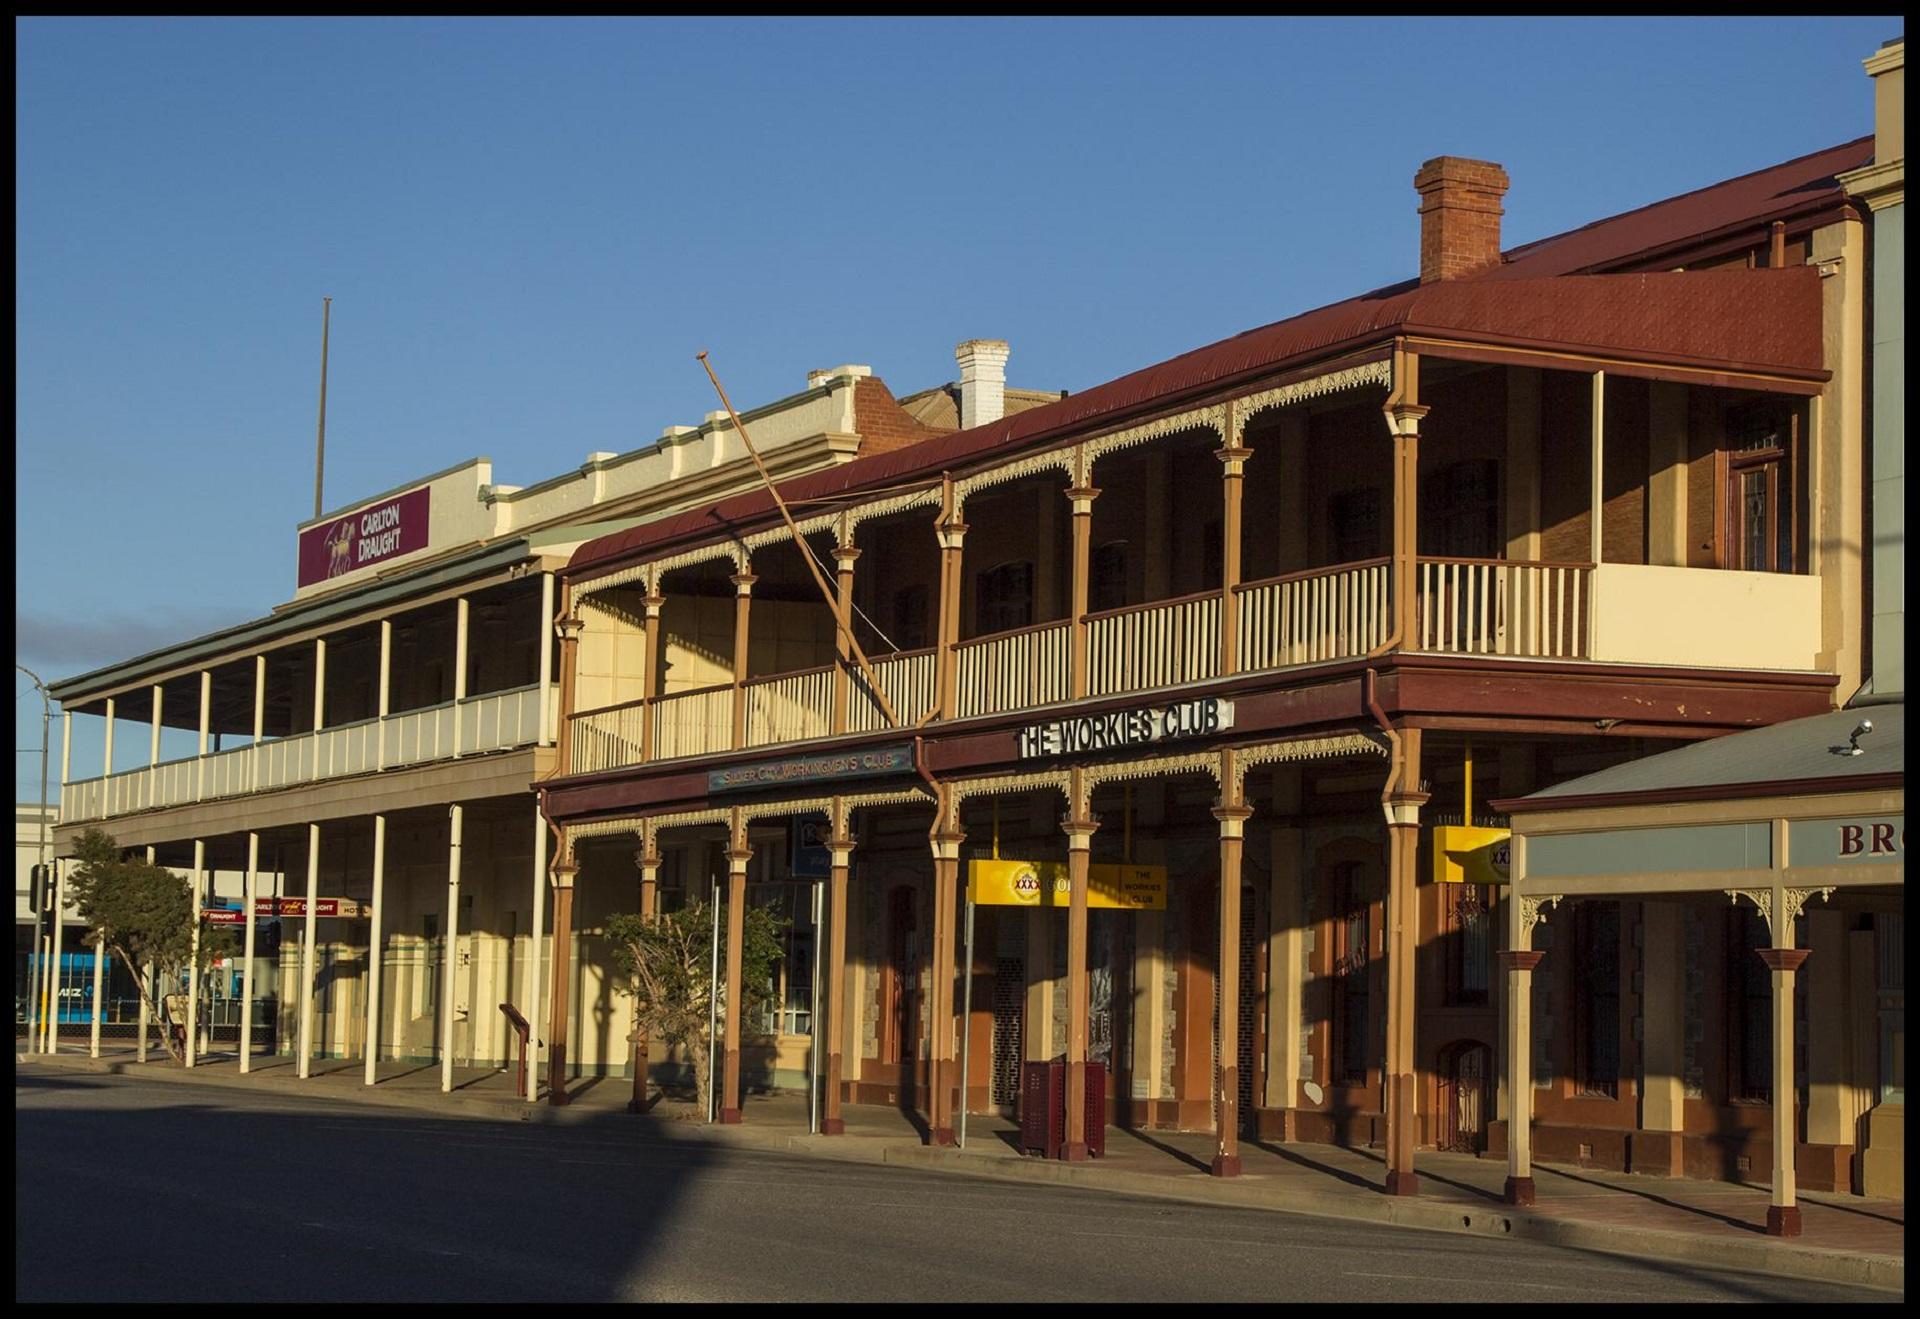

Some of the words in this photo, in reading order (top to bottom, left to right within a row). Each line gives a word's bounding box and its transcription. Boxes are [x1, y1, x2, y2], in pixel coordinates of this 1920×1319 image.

[361, 503, 400, 537] CARLTON
[358, 527, 401, 562] DRAUGHT
[1017, 724, 1059, 760] THE
[1060, 709, 1154, 754] WORKIES
[1162, 698, 1219, 738] CLUB
[863, 752, 893, 769] CLUB
[1838, 823, 1904, 858] BR
[1135, 871, 1151, 880] THE
[1014, 879, 1040, 890] XXXX
[1125, 883, 1161, 892] WORKIES
[1132, 895, 1153, 904] CLUB
